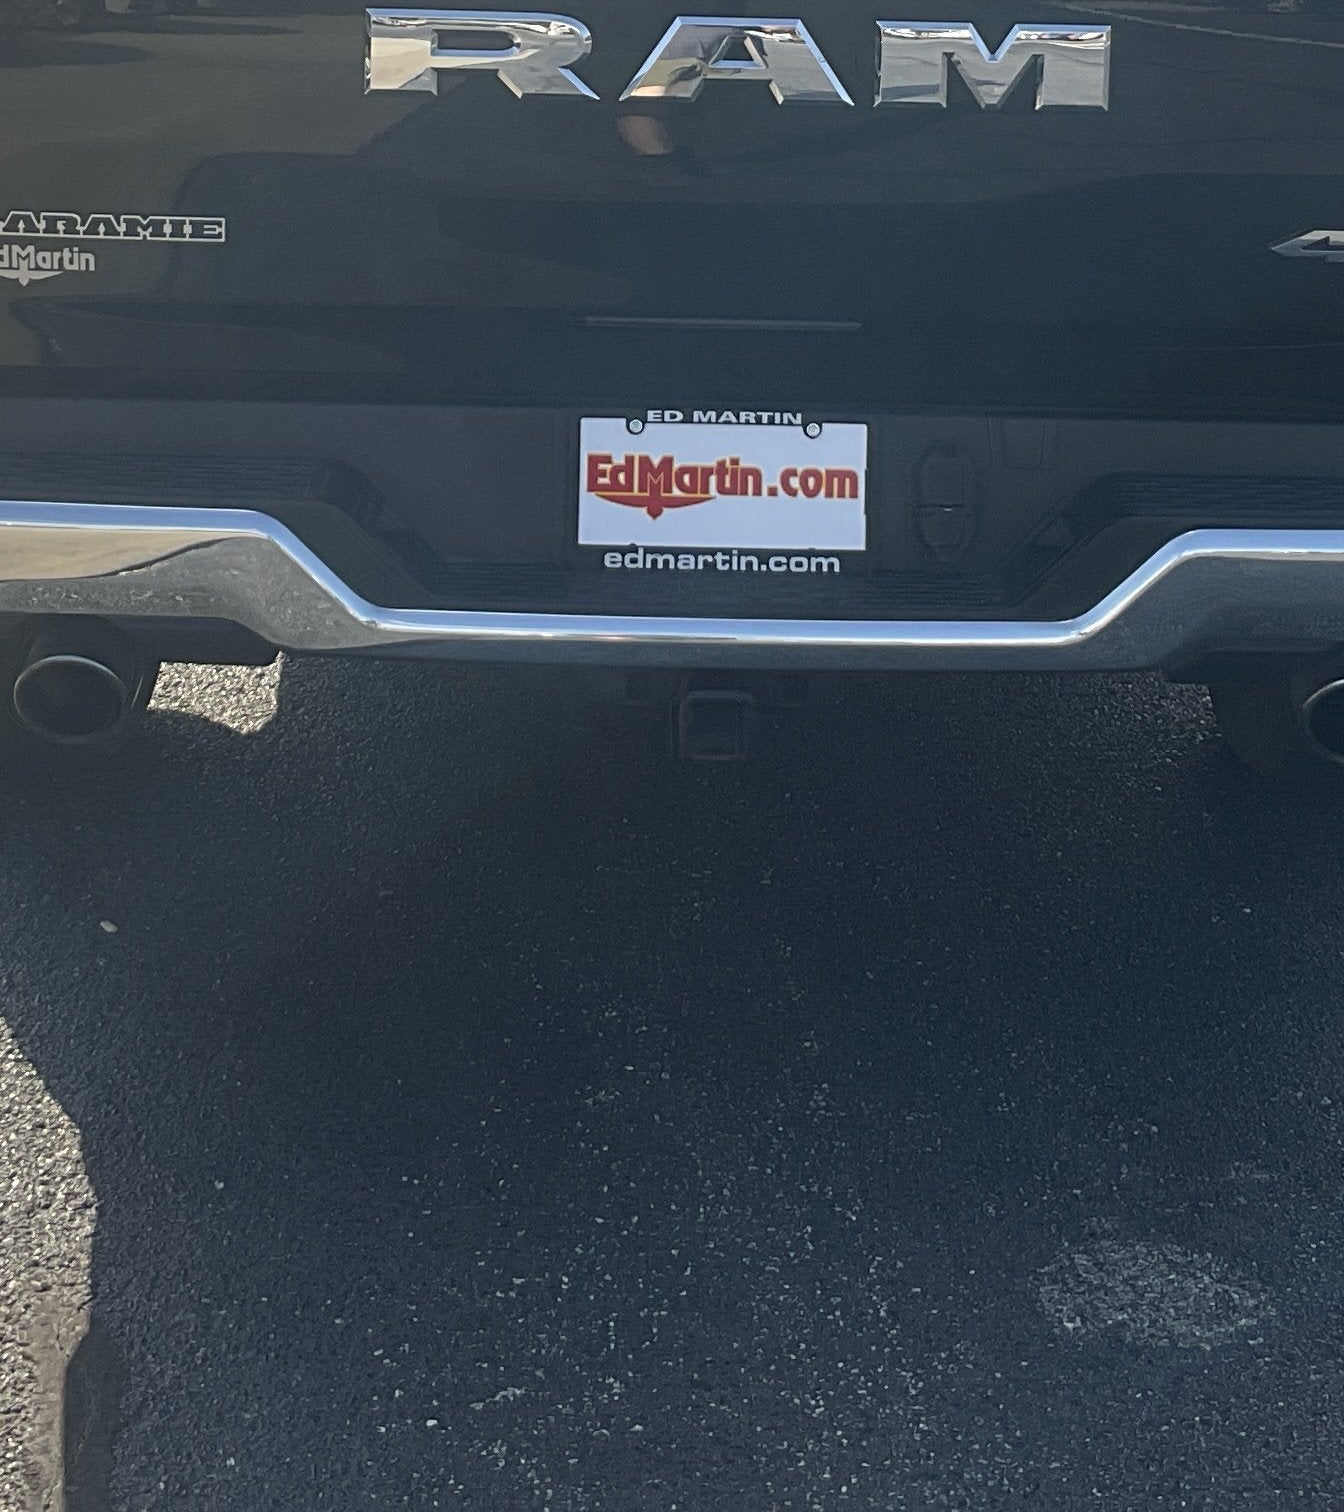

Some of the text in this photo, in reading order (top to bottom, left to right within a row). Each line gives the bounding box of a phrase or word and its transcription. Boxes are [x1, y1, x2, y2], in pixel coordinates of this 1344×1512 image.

[363, 6, 1112, 112] RAM
[646, 410, 803, 425] ED MARTIN
[586, 452, 859, 501] EdMartin.com
[603, 547, 841, 574] edmartin.com
